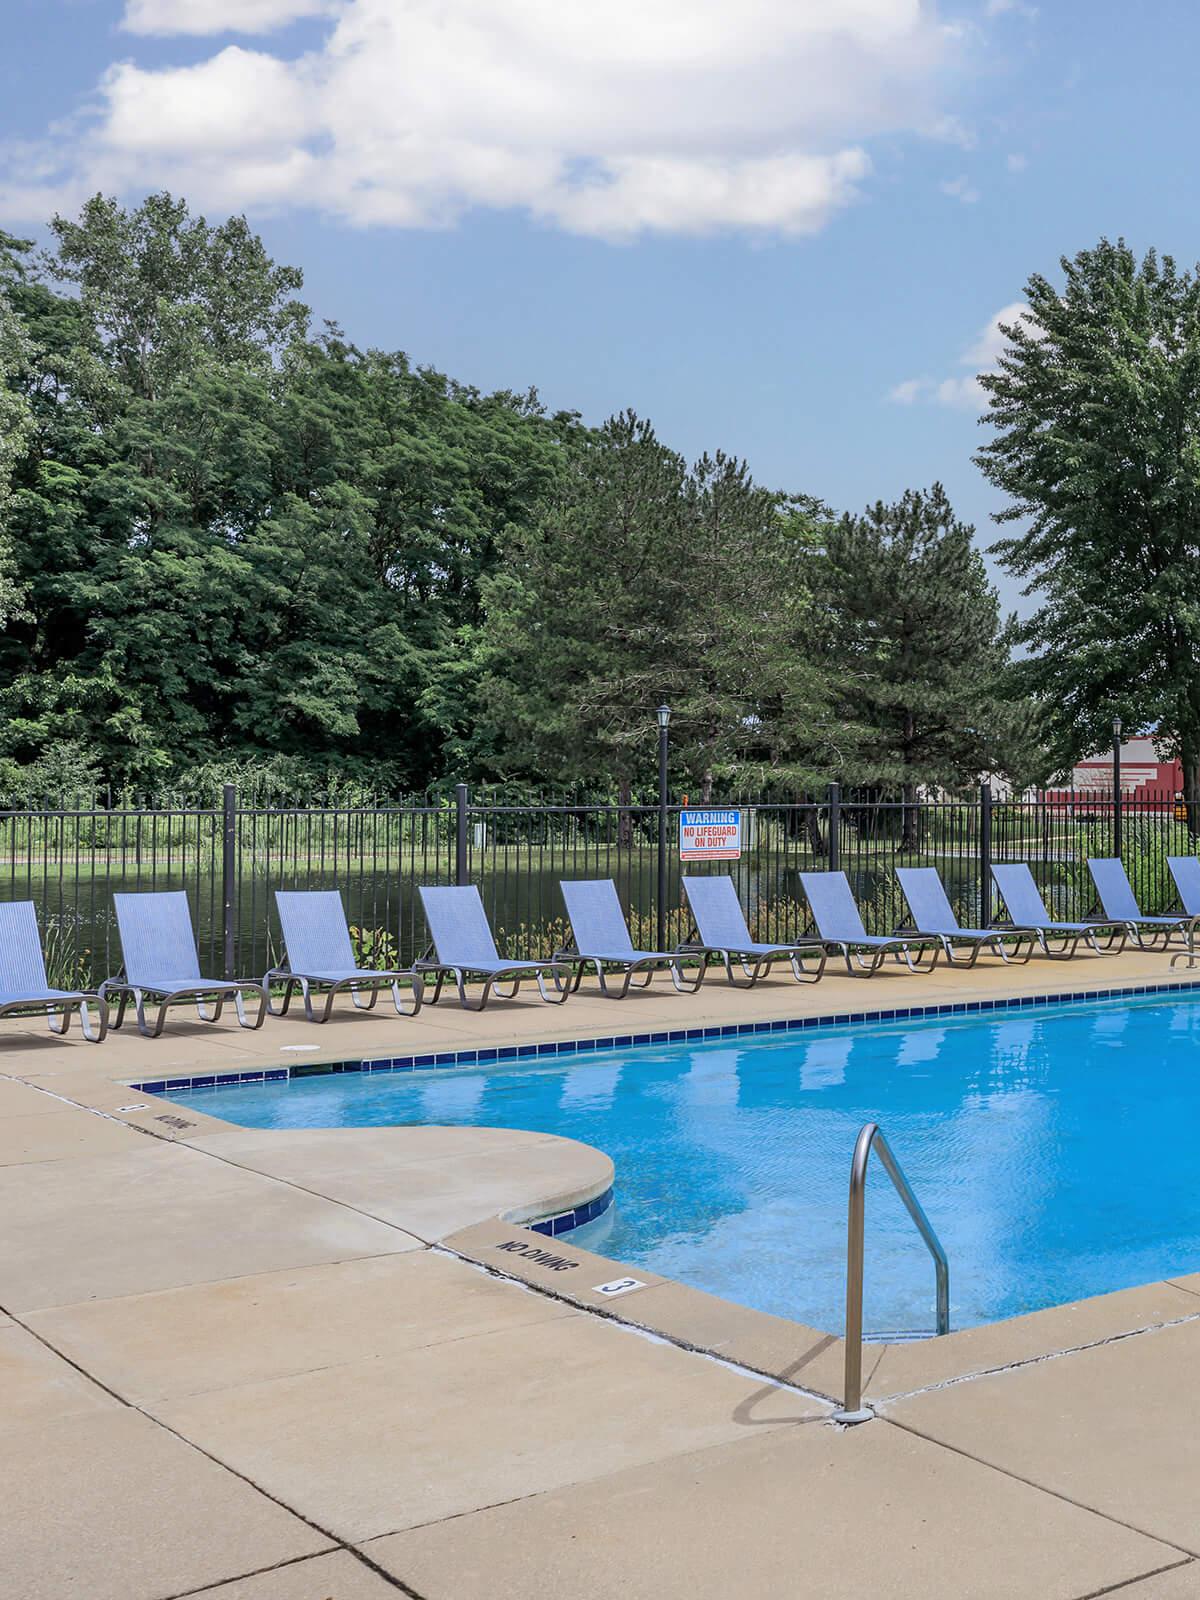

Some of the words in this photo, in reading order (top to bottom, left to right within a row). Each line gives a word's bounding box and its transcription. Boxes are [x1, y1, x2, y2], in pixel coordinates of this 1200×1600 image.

[686, 813, 735, 824] WARNING
[683, 827, 695, 837] NO
[697, 826, 737, 837] LIFEGUARD
[694, 837, 705, 847] ON
[707, 837, 727, 847] DUTY
[495, 1240, 529, 1252] NO
[518, 1248, 580, 1271] DIVING
[601, 1280, 636, 1292] 3
